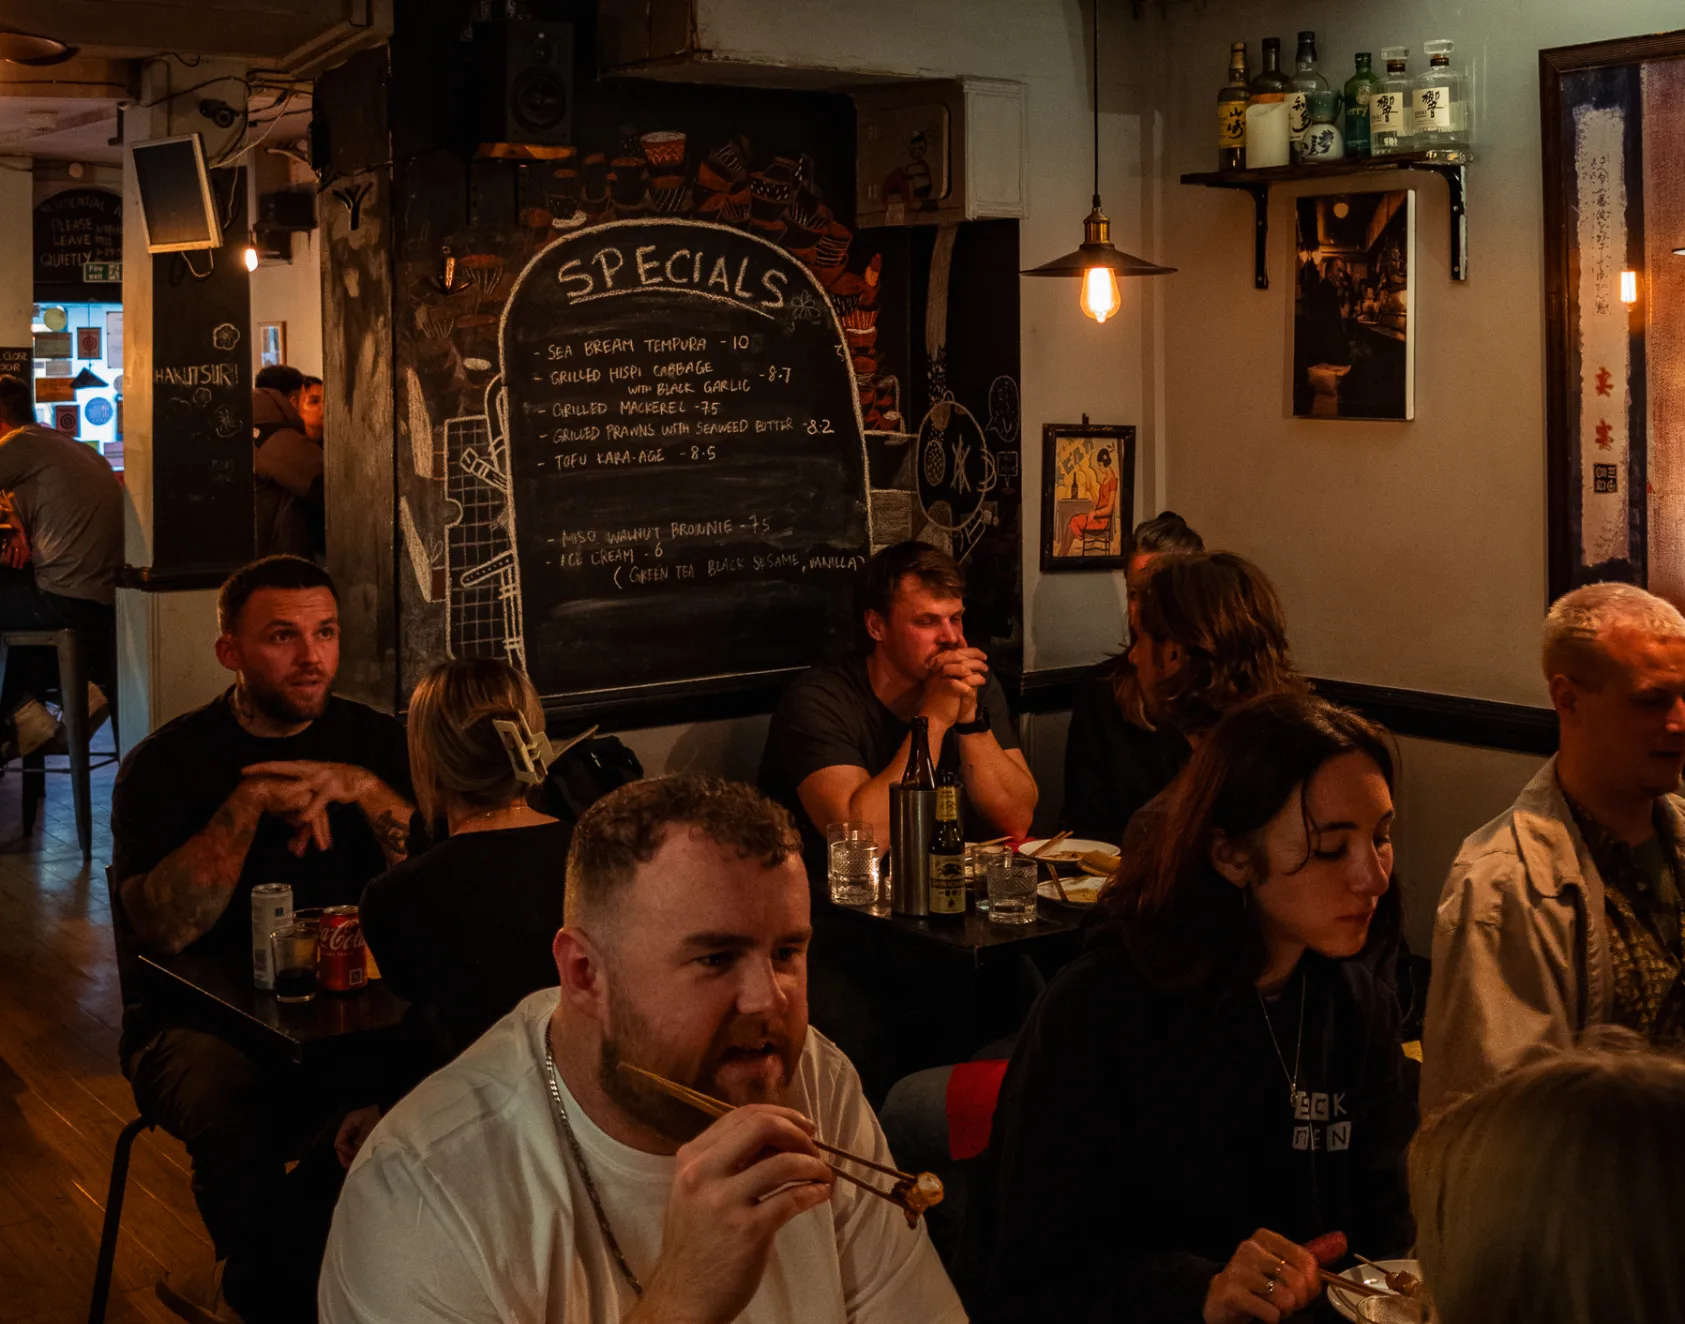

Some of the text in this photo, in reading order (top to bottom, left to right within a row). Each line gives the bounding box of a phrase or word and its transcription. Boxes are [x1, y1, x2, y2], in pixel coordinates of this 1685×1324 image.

[51, 216, 93, 233] PLEASE
[53, 234, 92, 246] LEAVE
[40, 249, 92, 267] QUIETLY
[558, 245, 788, 308] SPECIALS
[548, 344, 573, 360] SEA
[585, 339, 634, 356] BREAM
[644, 336, 707, 353] TEMPURA
[551, 360, 714, 385] GRILLED HISPI CABBAGE
[657, 382, 695, 396] BLACK
[704, 379, 750, 393] GARLIC
[553, 403, 607, 417] GRILLED
[620, 401, 686, 415] MACKEREL
[553, 426, 600, 443] GRILLED
[606, 424, 655, 440] PRAWNS
[661, 422, 689, 436] WITH
[696, 419, 748, 434] SEAWEED
[755, 417, 794, 433] BUTTER
[554, 453, 587, 470] TOFU
[597, 448, 665, 464] KARA-AGE
[562, 530, 596, 547] MISO
[607, 527, 660, 544] WALNUT
[671, 519, 732, 539] BROWNIE
[560, 553, 583, 567] ICE
[591, 549, 634, 566] CREAM
[676, 565, 695, 579] TEA
[708, 557, 744, 577] BLACK
